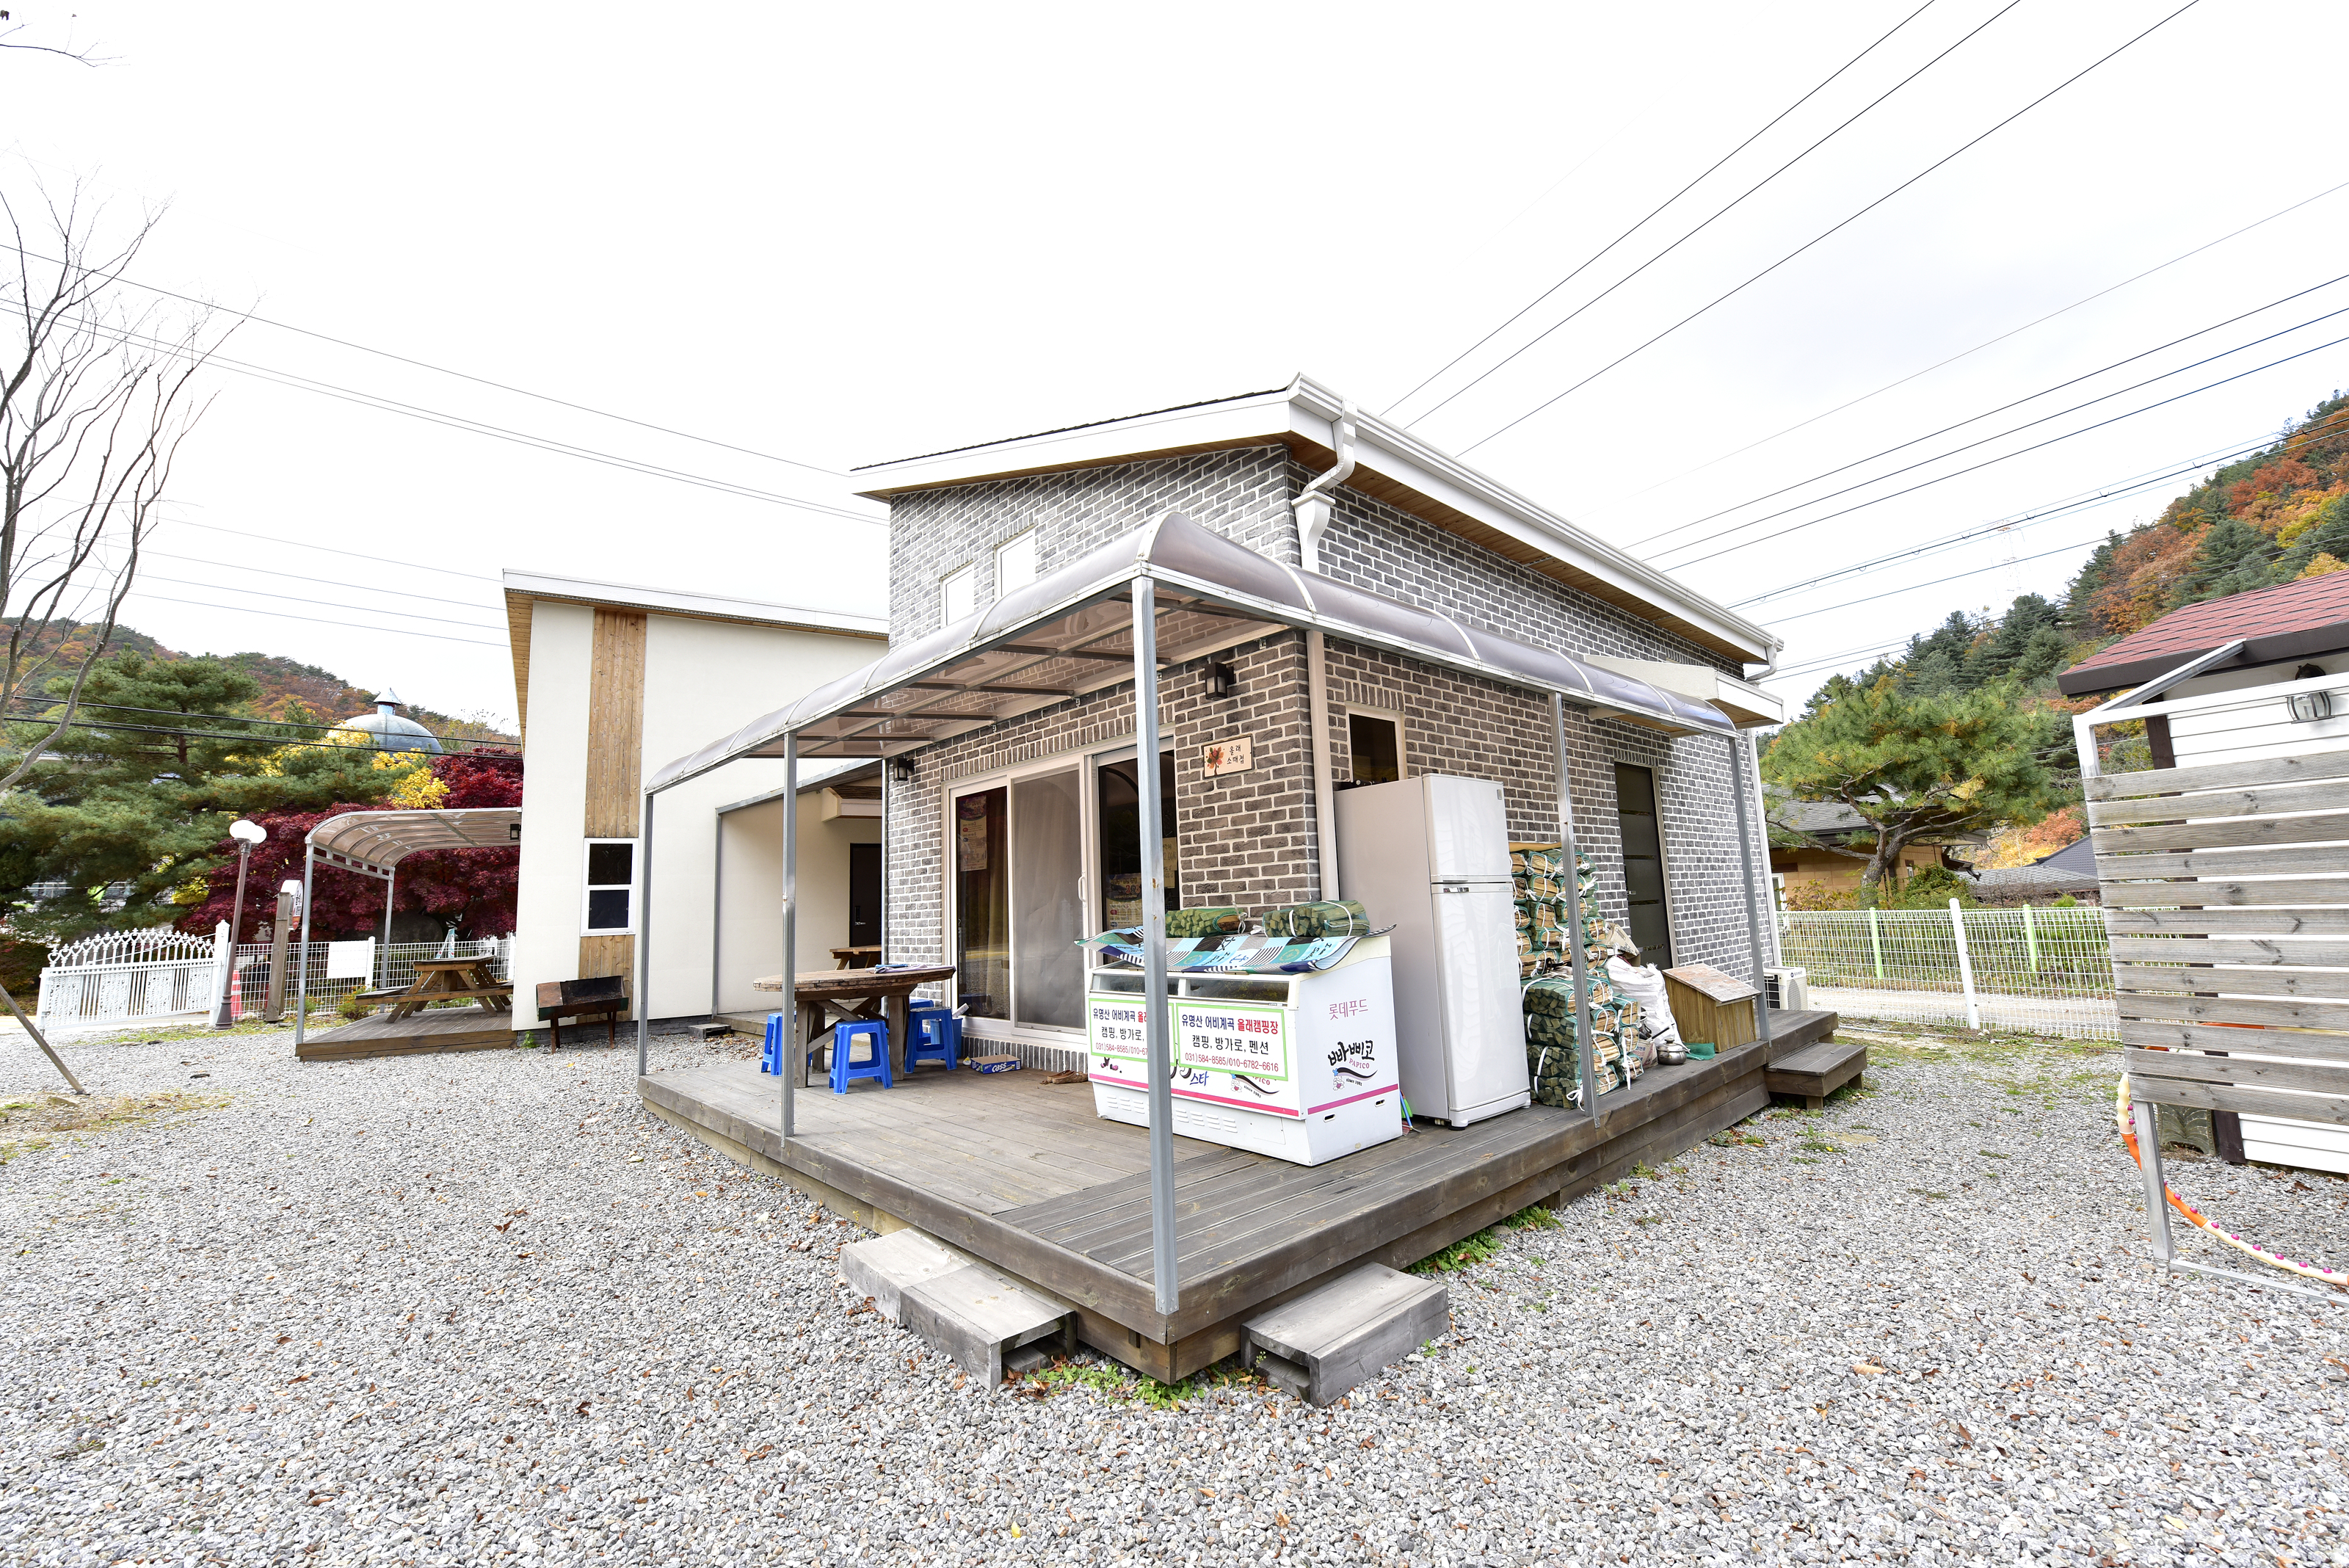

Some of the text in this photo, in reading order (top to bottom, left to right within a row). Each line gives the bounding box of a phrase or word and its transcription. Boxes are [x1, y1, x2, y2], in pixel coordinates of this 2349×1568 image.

[1230, 744, 1241, 756] 올래
[1227, 754, 1244, 765] 소매점
[1093, 1008, 1110, 1020] 유명산
[1111, 1009, 1136, 1023] 어비계곡
[1329, 998, 1369, 1021] 롯데푸드
[1182, 1014, 1279, 1034] 유명산 어비계곡 올래캠핑장
[1101, 1026, 1144, 1042] 캠핑, 방가로,
[1095, 1042, 1148, 1056] 031)584-8585/010-67
[1192, 1034, 1269, 1056] 캠핑, 방가로, 펜션
[1327, 1039, 1376, 1067] 빠삐코
[1185, 1052, 1279, 1072] 031)584-8585/010-6782-6616
[1348, 1057, 1370, 1070] PAPICO
[1189, 1070, 1210, 1086] 스타
